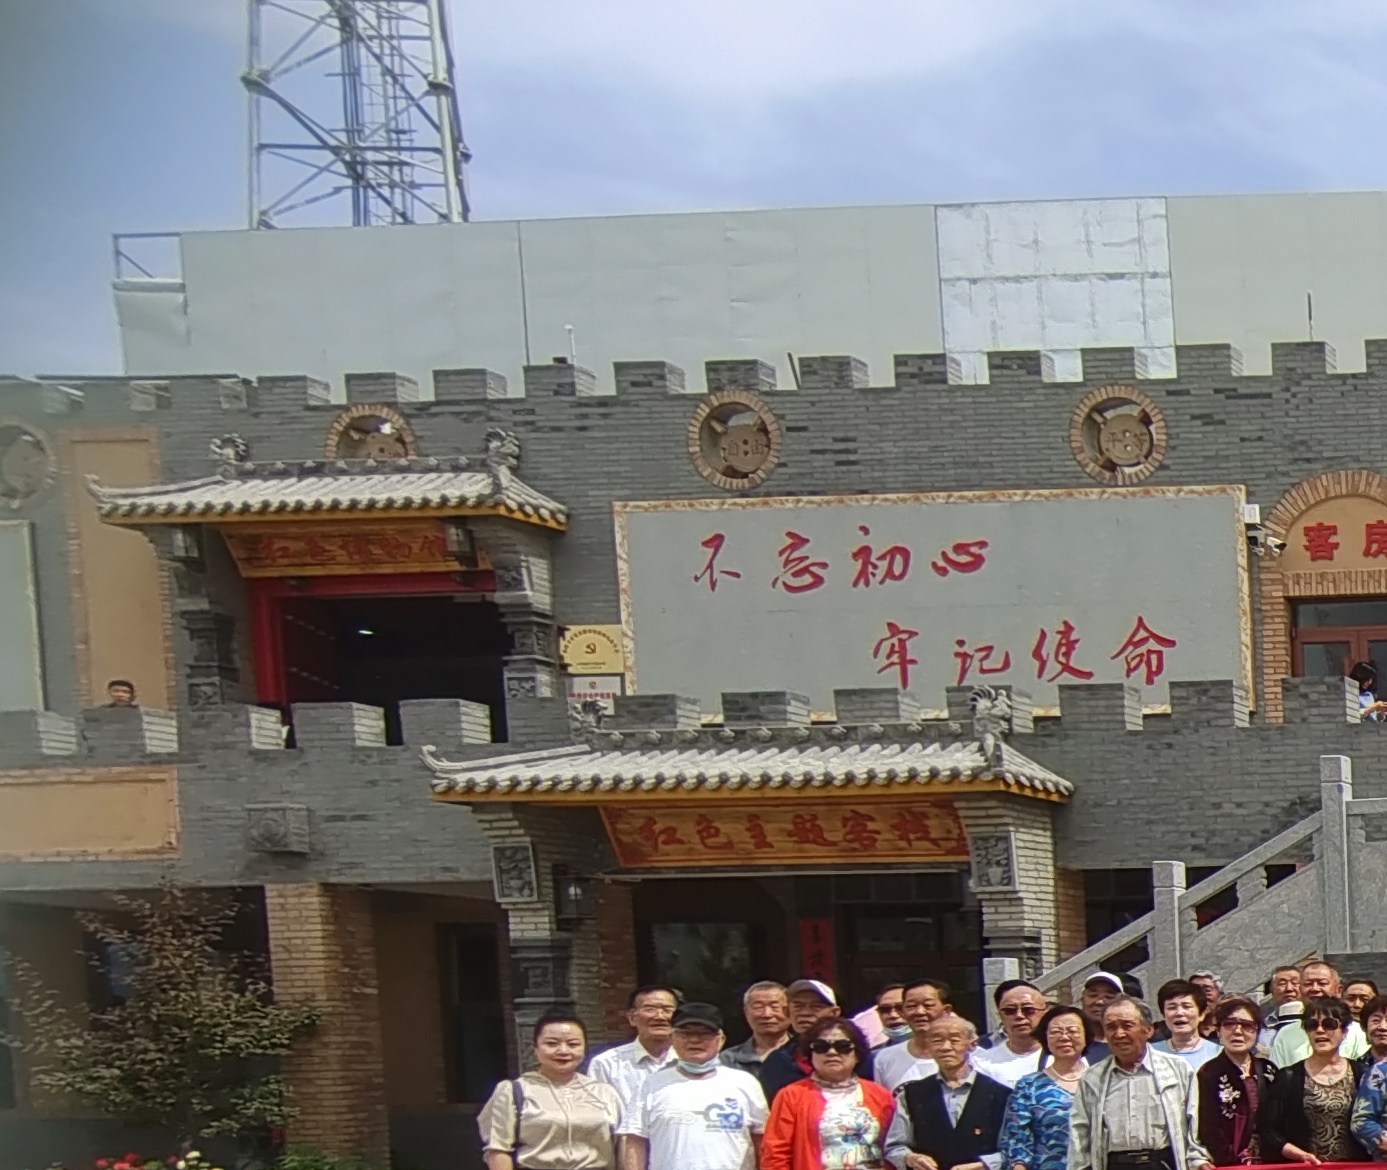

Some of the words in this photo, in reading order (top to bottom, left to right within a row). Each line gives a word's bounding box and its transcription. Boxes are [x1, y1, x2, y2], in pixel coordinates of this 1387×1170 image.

[693, 525, 989, 594] 不忘初心
[872, 615, 1177, 689] 牢记使命
